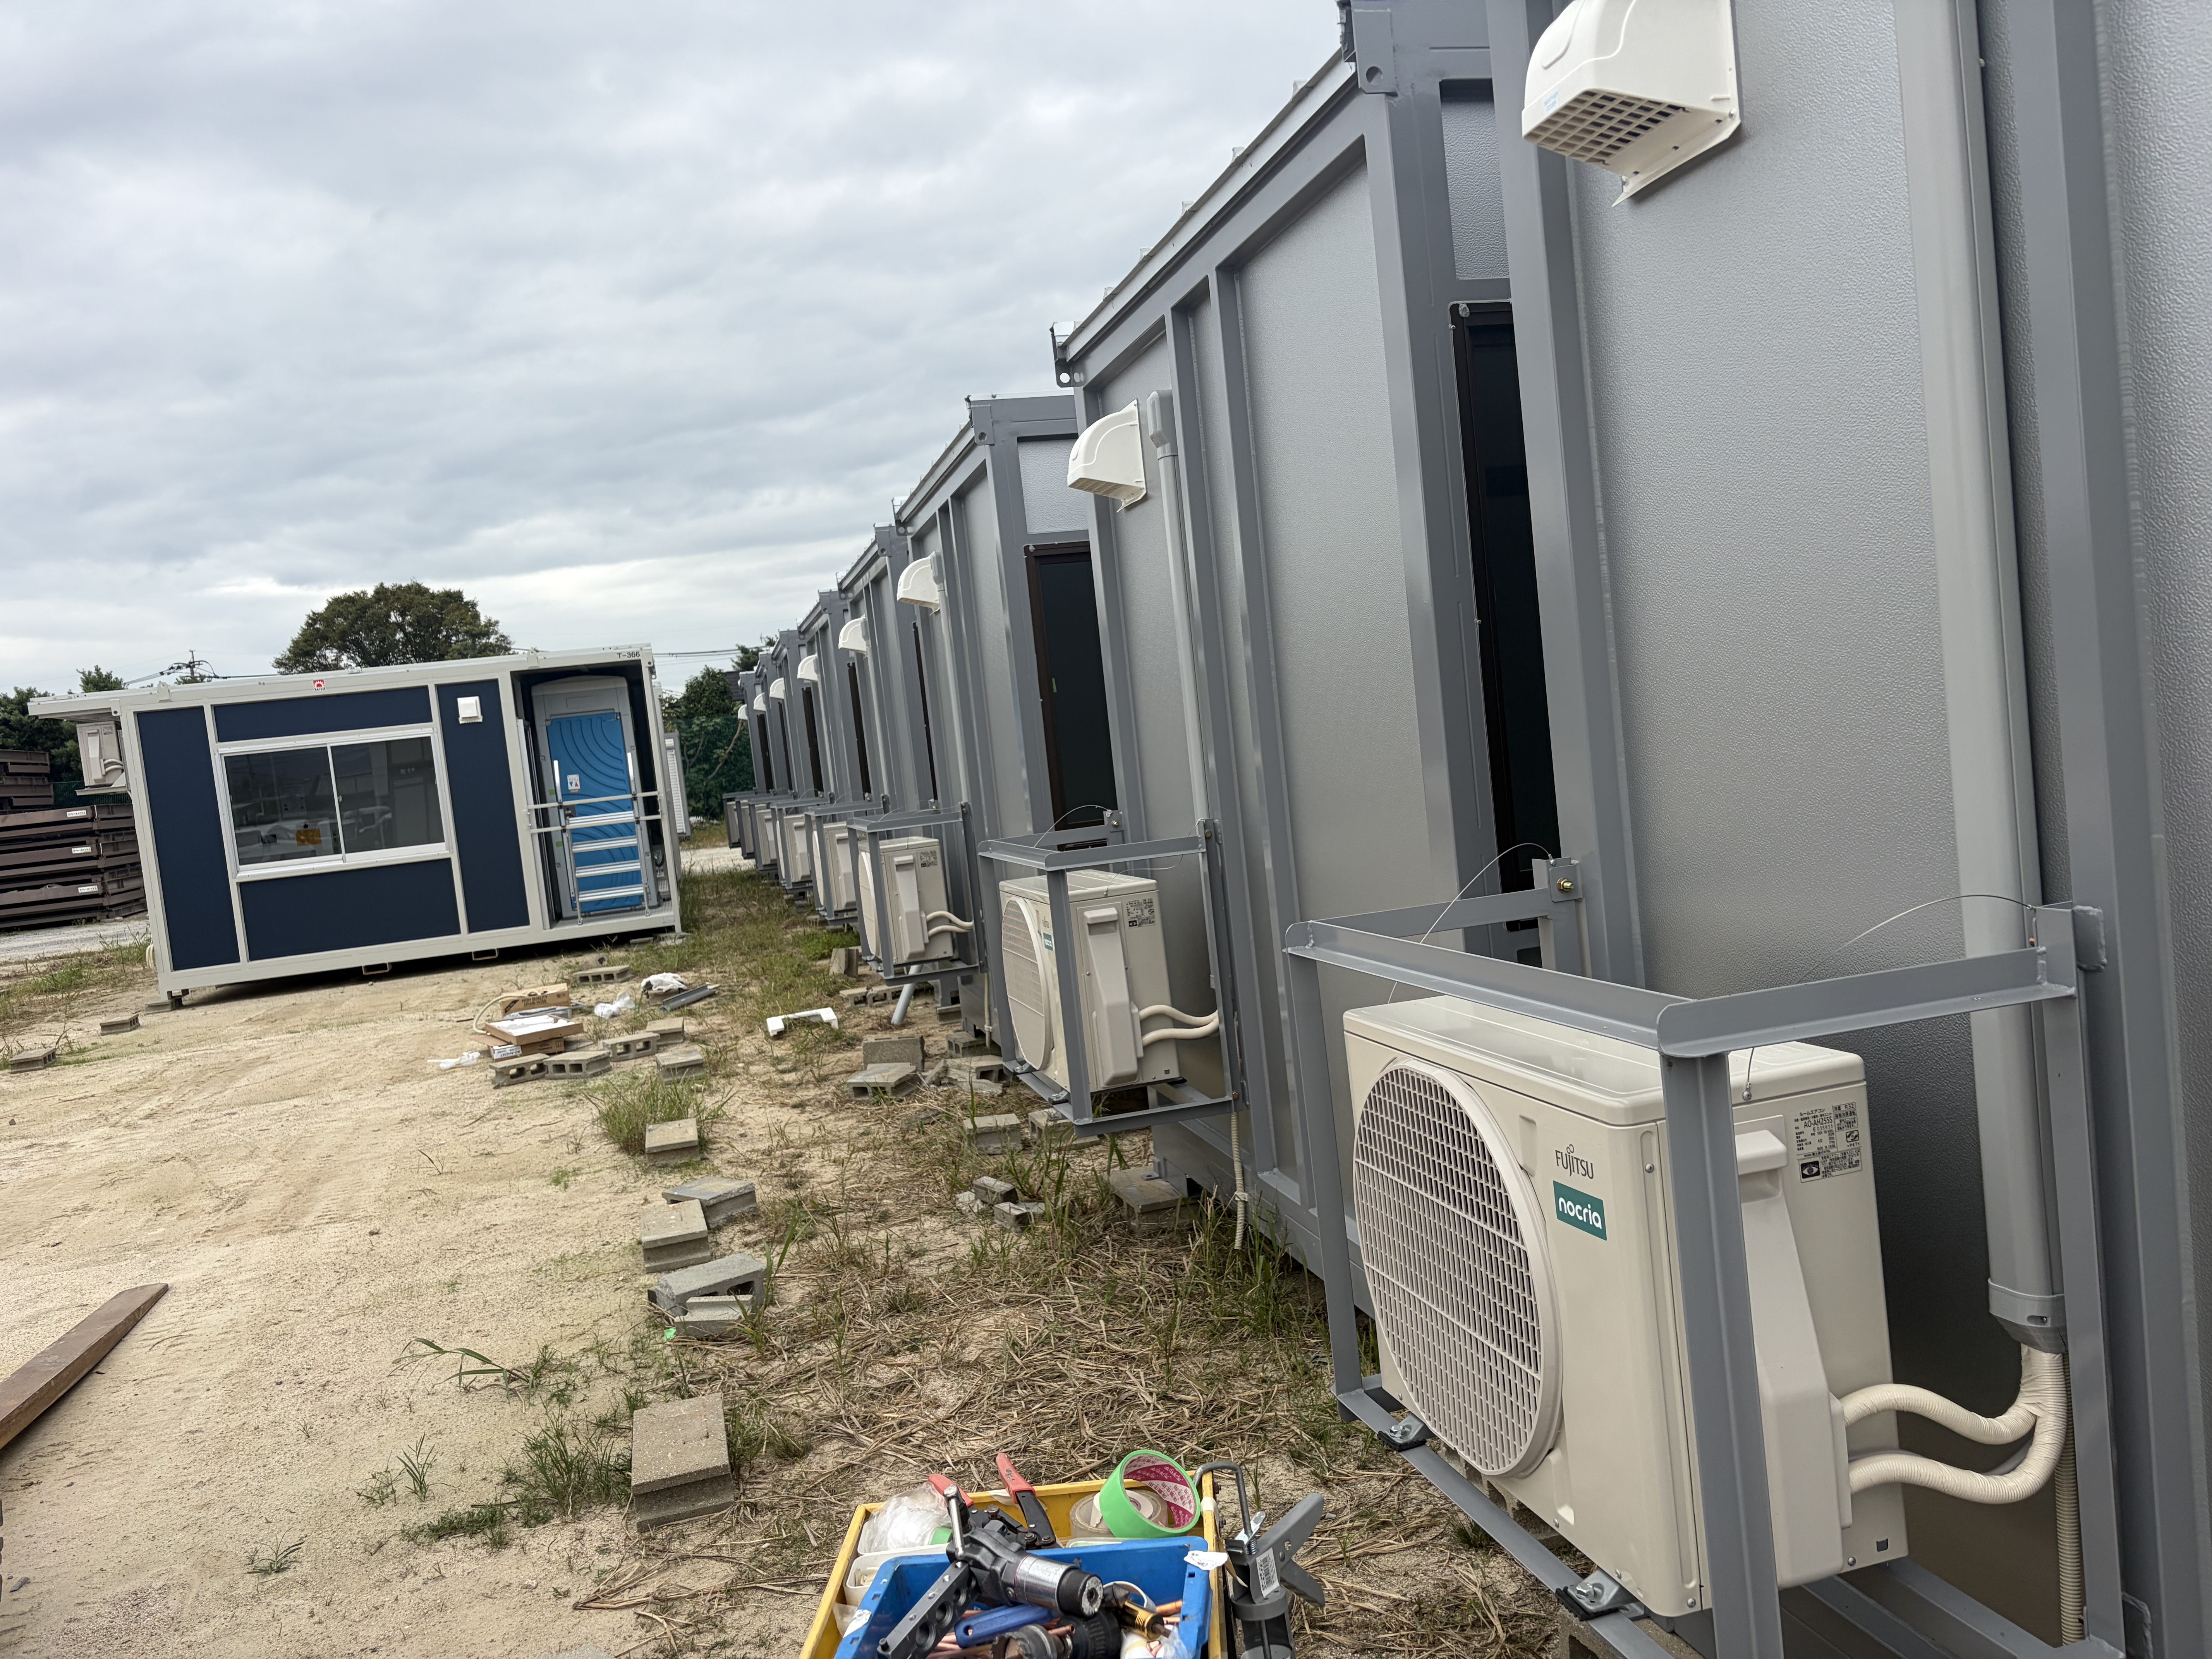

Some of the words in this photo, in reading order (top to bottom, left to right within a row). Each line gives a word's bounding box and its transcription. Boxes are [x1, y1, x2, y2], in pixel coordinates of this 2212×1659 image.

[1799, 1108, 1825, 1117] ルームエアコン
[1804, 1116, 1833, 1128] AO-AH255S
[1555, 1144, 1594, 1180] FUJITSU
[1558, 1197, 1602, 1230] nocria
